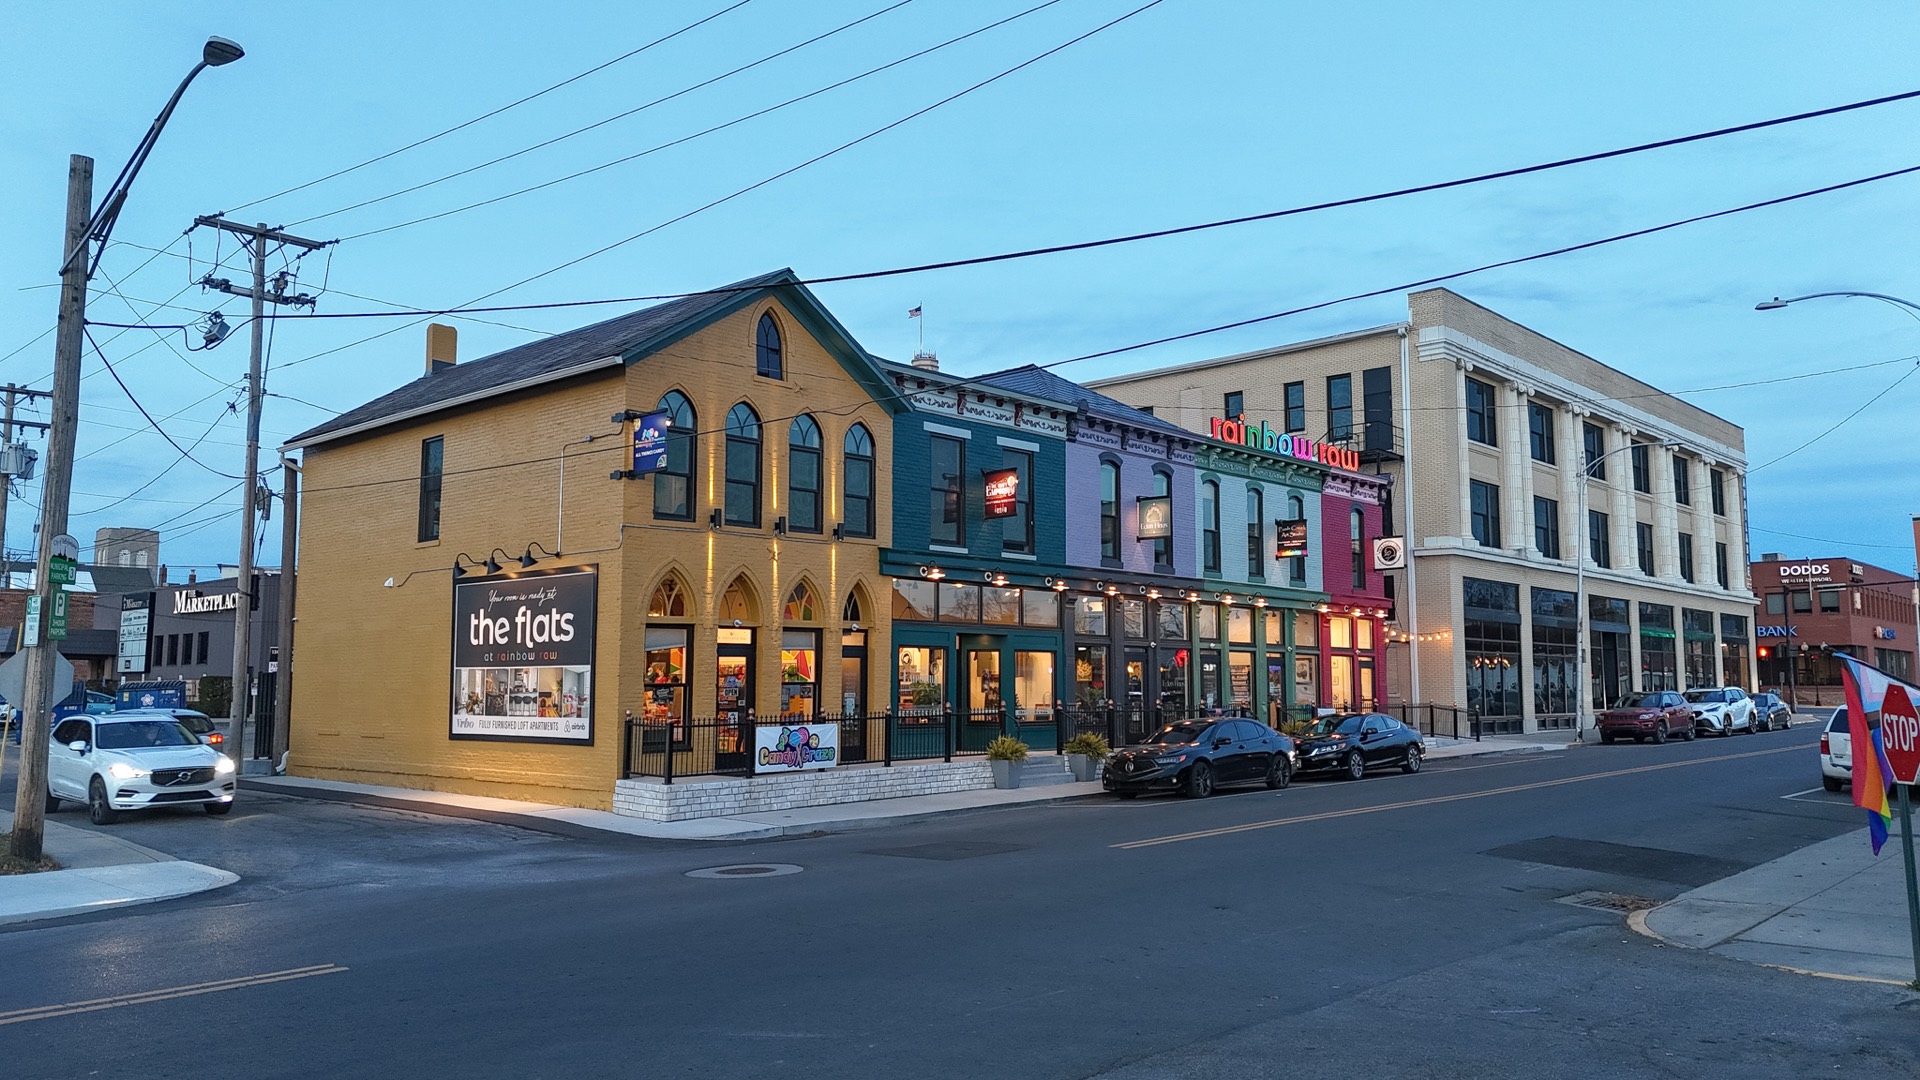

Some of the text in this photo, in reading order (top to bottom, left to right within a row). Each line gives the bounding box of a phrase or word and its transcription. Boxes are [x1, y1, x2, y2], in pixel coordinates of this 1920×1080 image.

[1211, 413, 1359, 472] rainbow row
[1780, 564, 1830, 577] DODDS
[488, 589, 503, 613] Your
[519, 592, 528, 600] is
[470, 605, 574, 648] the flats
[1757, 625, 1798, 638] BANK
[483, 651, 558, 661] at rainbow row
[456, 718, 586, 731] Vrbo FULLY FURNISHED LOFT APARTMENTS airbnb
[1883, 712, 1918, 752] STOP
[758, 745, 836, 768] Candy Craze
